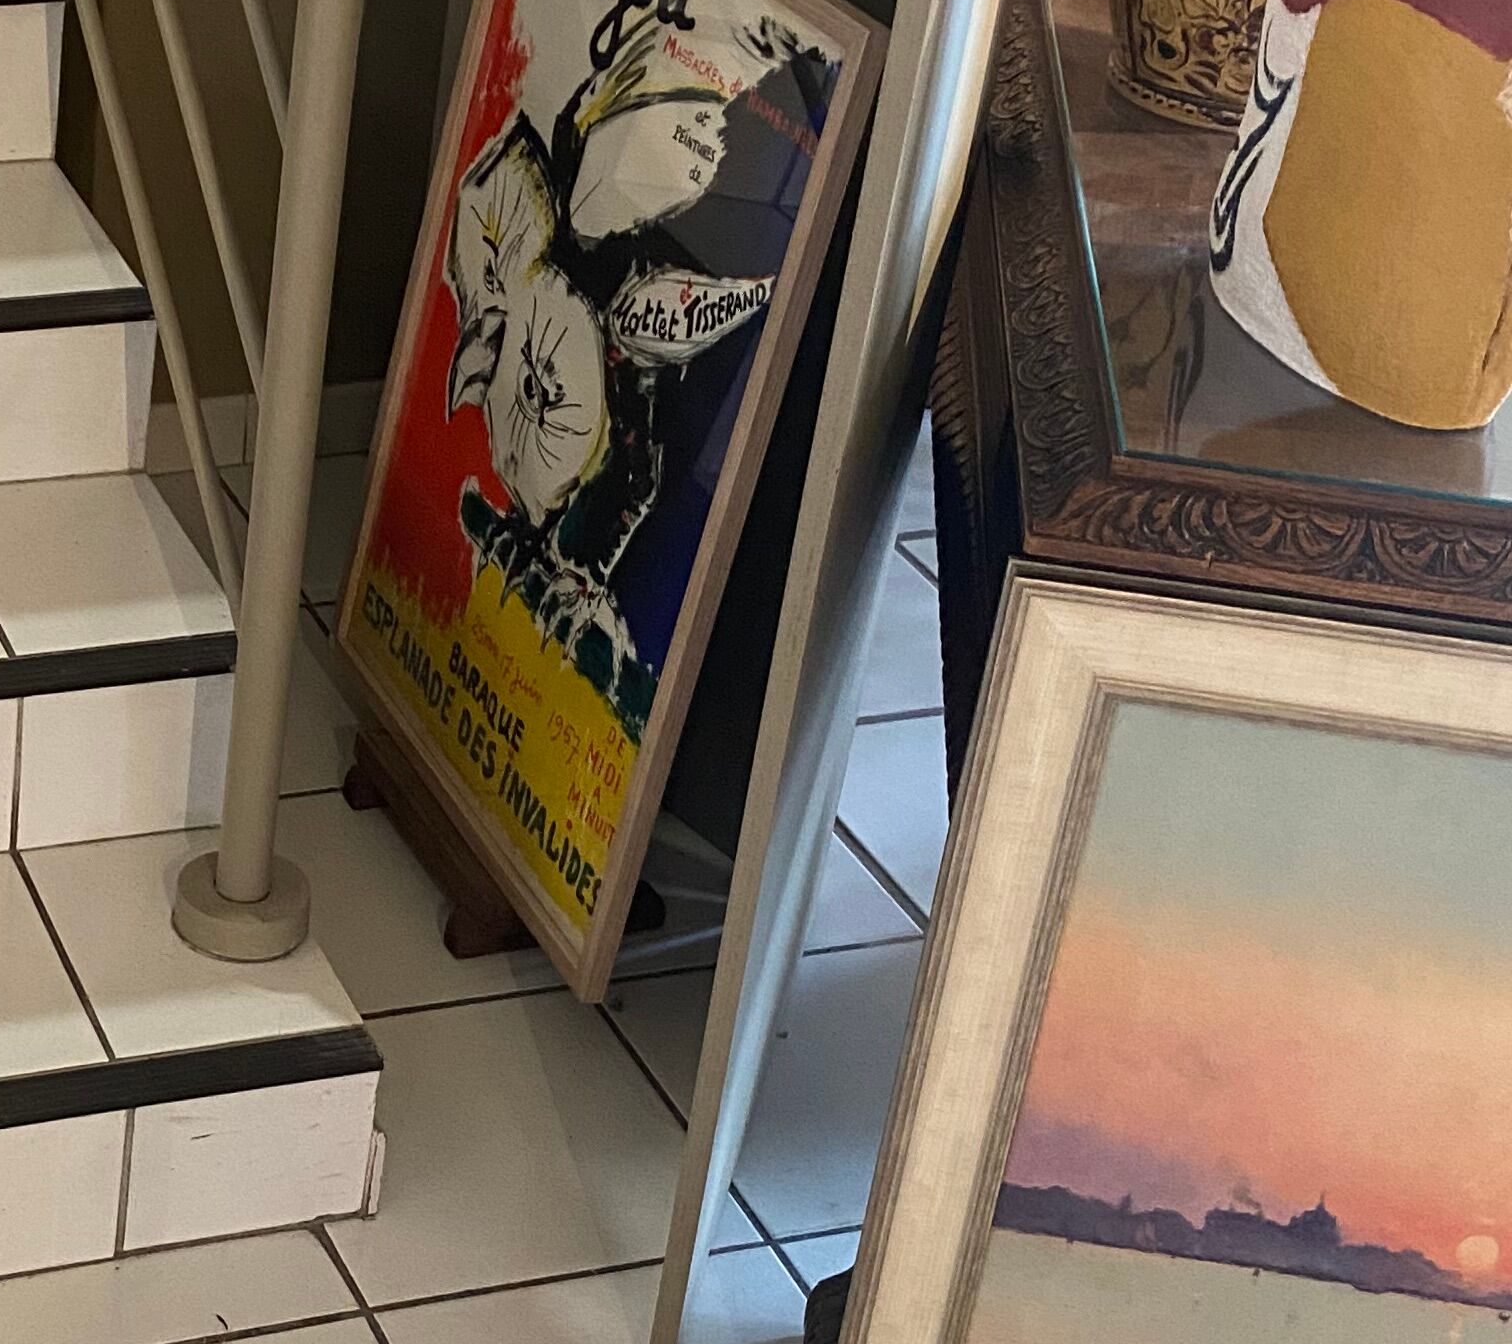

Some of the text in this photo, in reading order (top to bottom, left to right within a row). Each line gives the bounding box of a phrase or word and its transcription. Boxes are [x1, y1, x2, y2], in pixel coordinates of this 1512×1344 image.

[612, 292, 679, 342] Mottet
[361, 581, 456, 725] ESPLANADE
[457, 707, 498, 779] DES
[449, 641, 526, 753] BARAQUE
